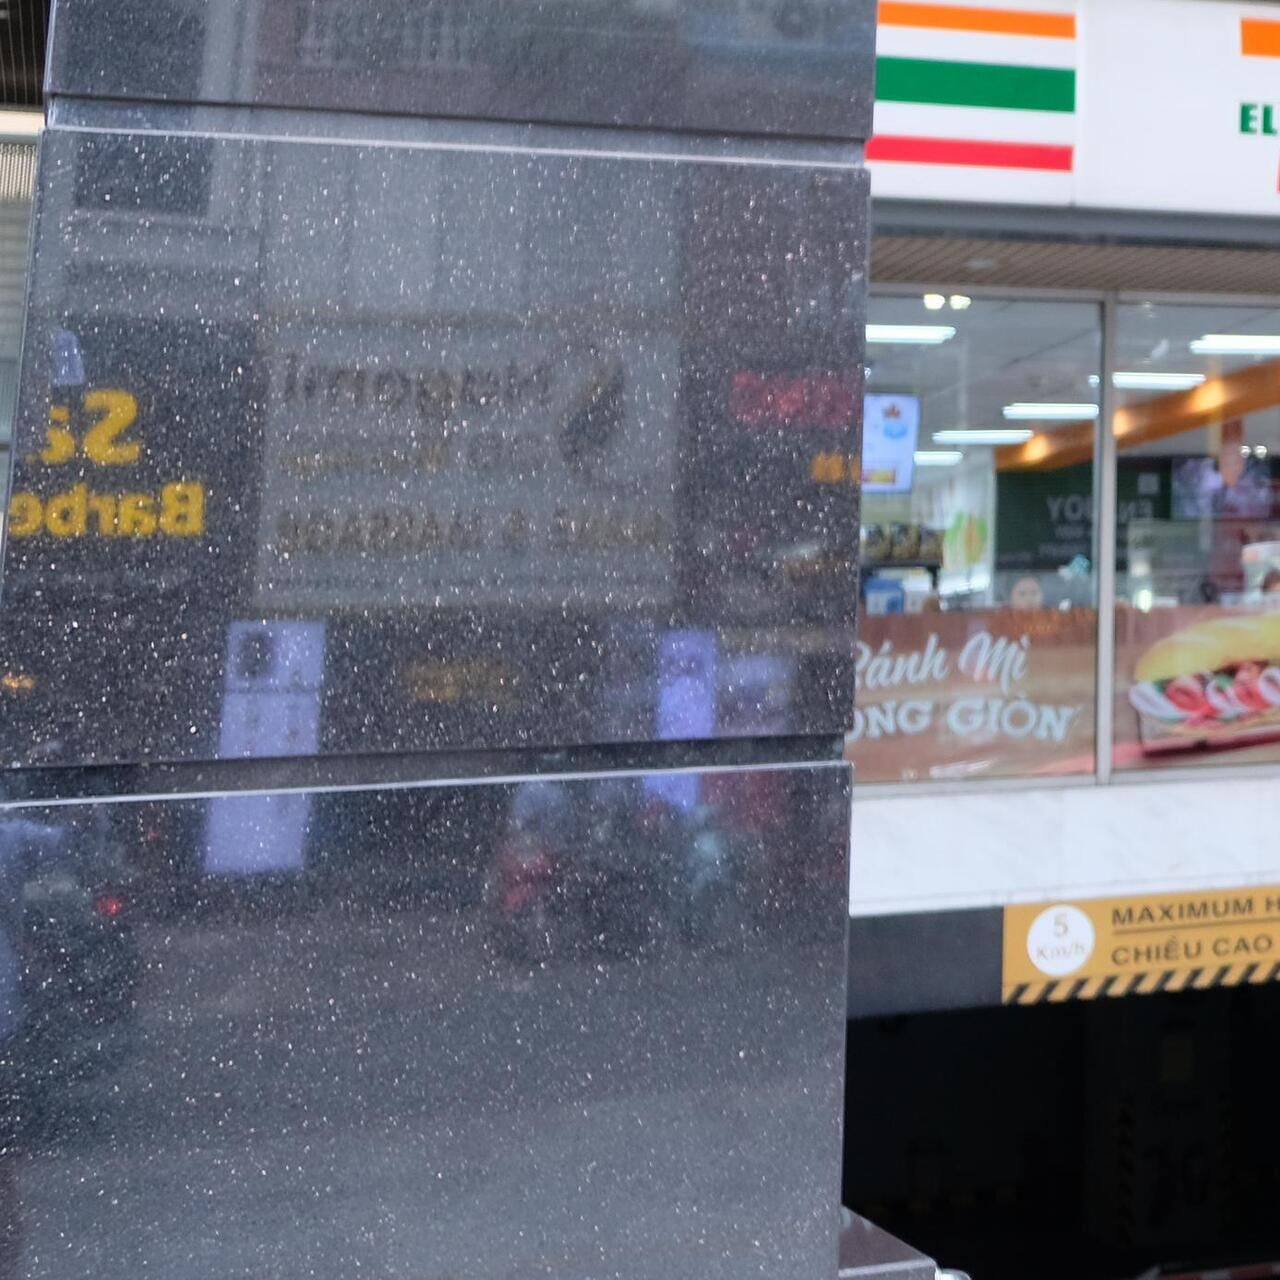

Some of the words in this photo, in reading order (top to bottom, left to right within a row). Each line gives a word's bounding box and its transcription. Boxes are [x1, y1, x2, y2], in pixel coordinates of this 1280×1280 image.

[1112, 898, 1254, 926] MAXIMUM
[1053, 913, 1069, 938] 5
[1212, 932, 1273, 957] CAO
